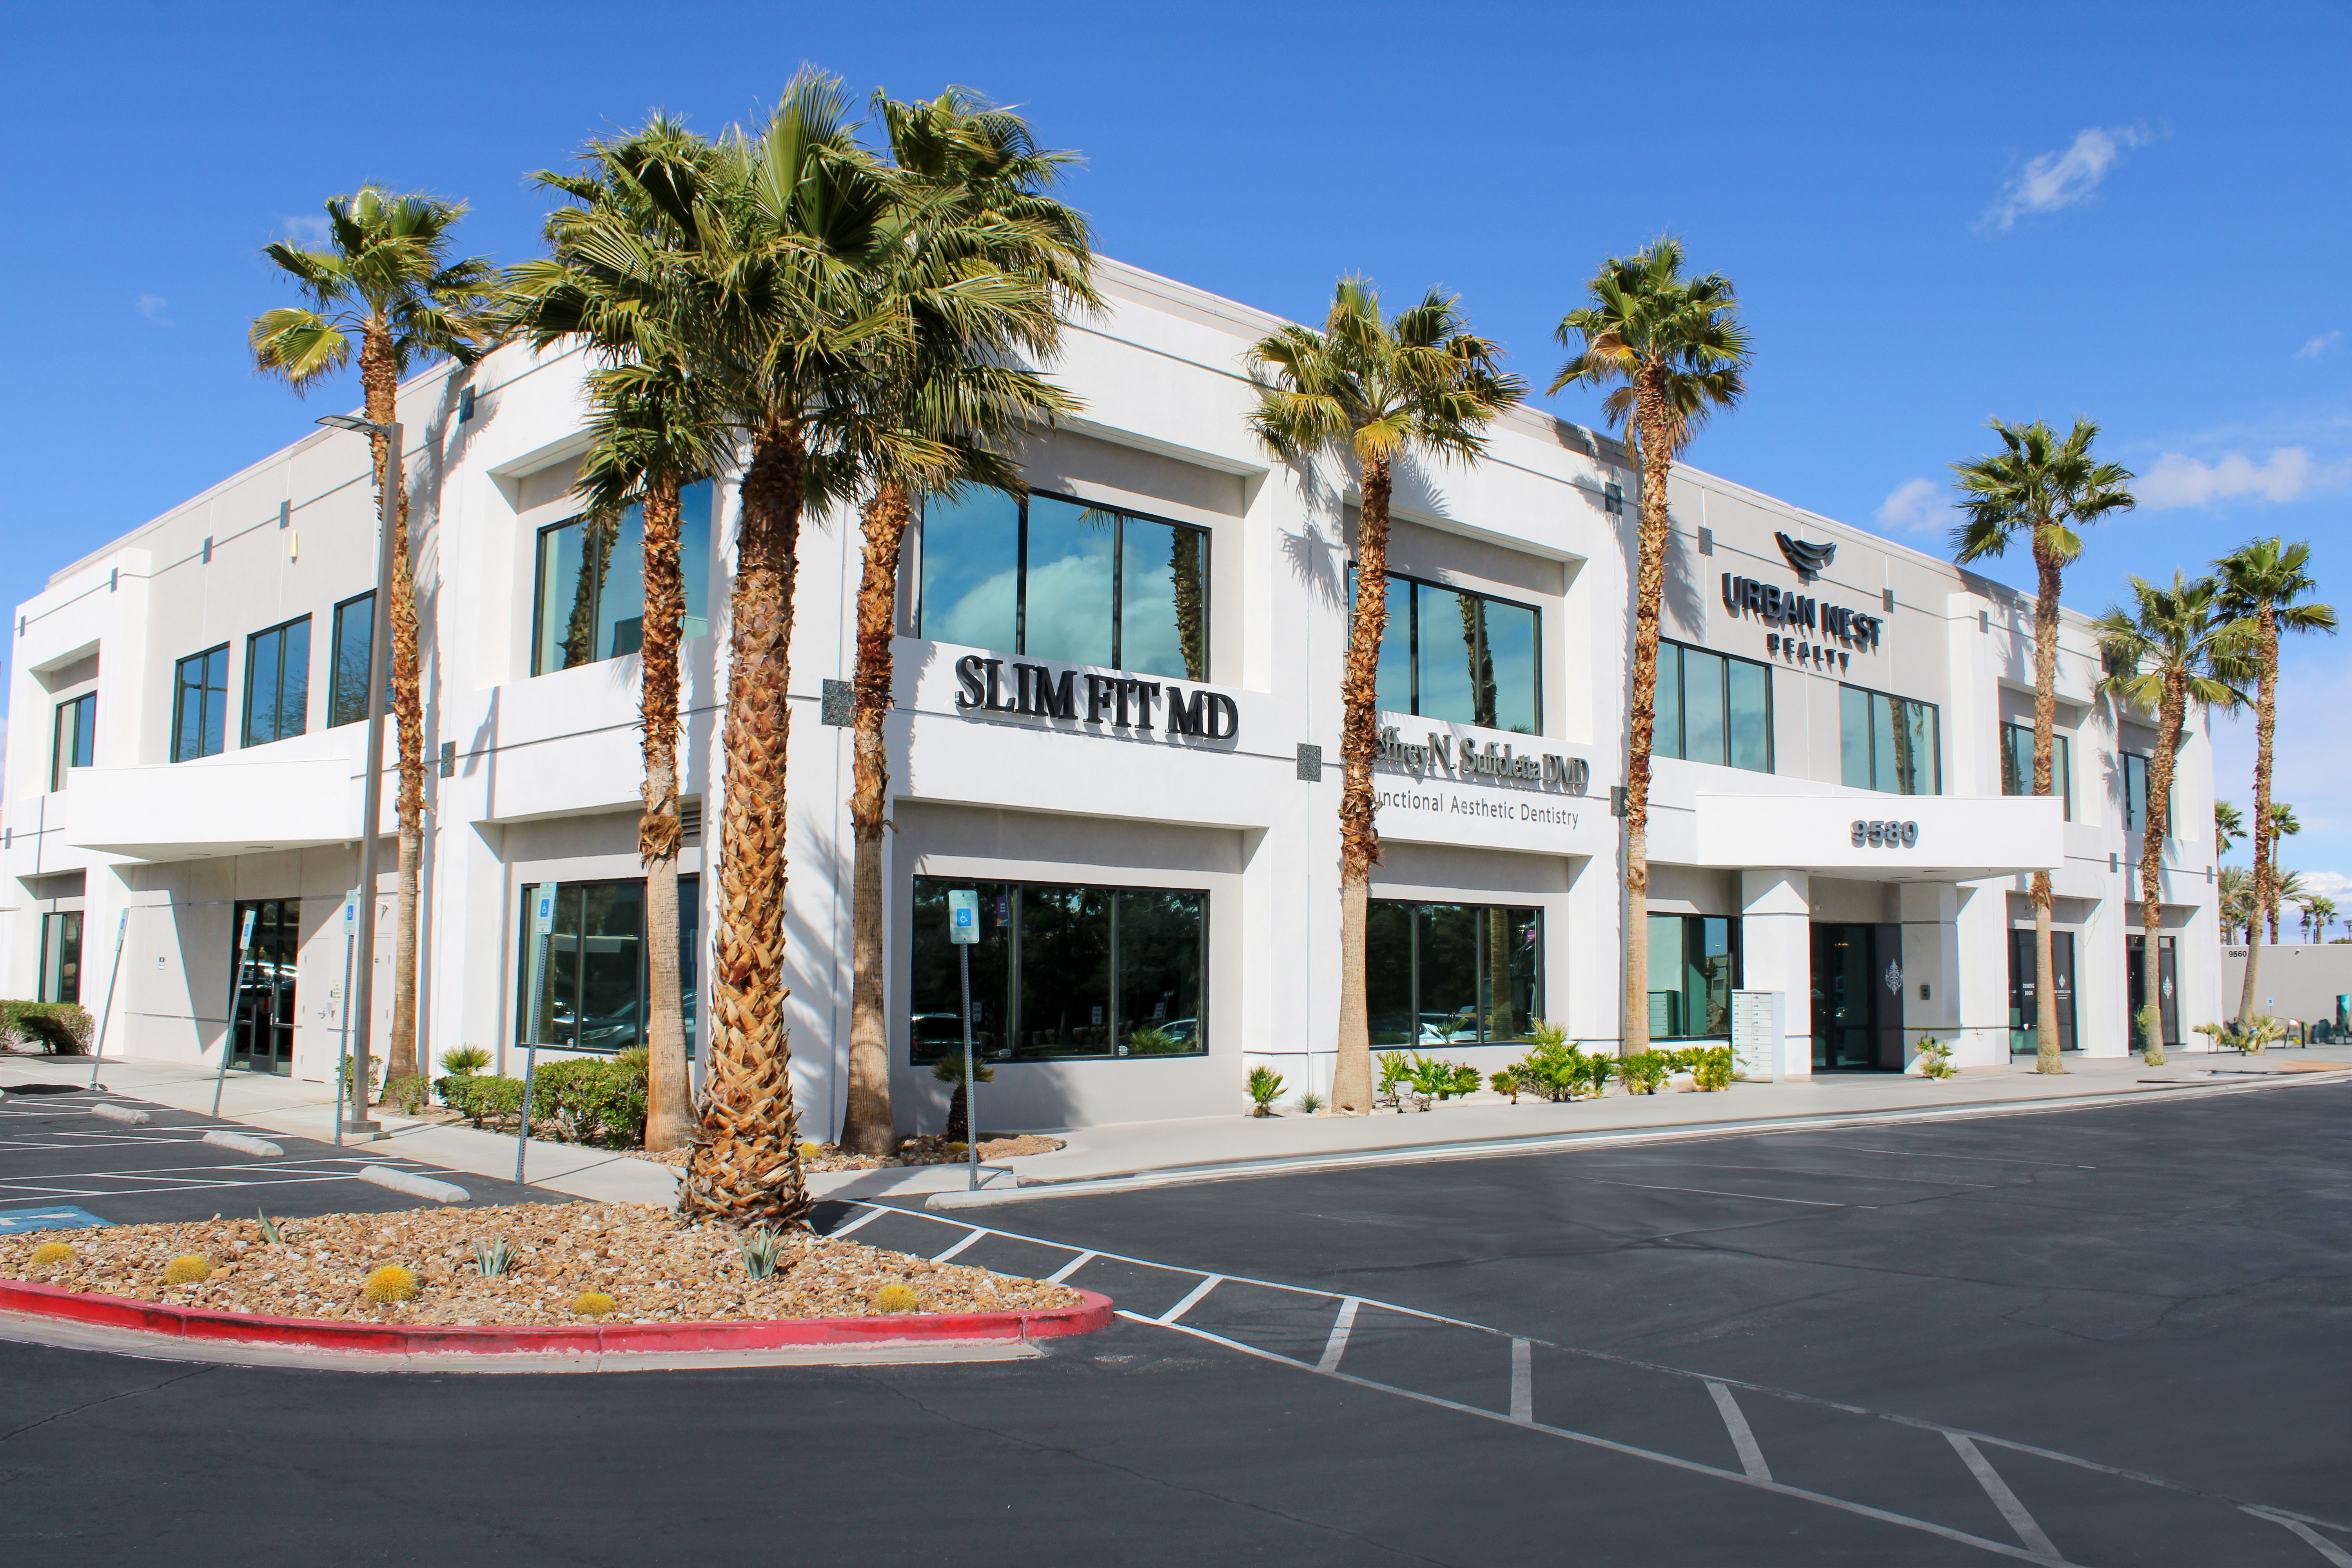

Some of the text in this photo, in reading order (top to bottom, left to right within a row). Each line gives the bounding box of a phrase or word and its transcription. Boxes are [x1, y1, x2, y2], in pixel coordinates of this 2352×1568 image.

[1722, 572, 1883, 647] URBAN NEST
[1767, 633, 1850, 668] REALTY
[955, 655, 1238, 740] SLIM FIT MD
[1375, 726, 1589, 786] effrey N. Suffoletta DMD
[1375, 789, 1579, 830] unctional Aesthetic Dentistry
[1850, 820, 1918, 842] 9580
